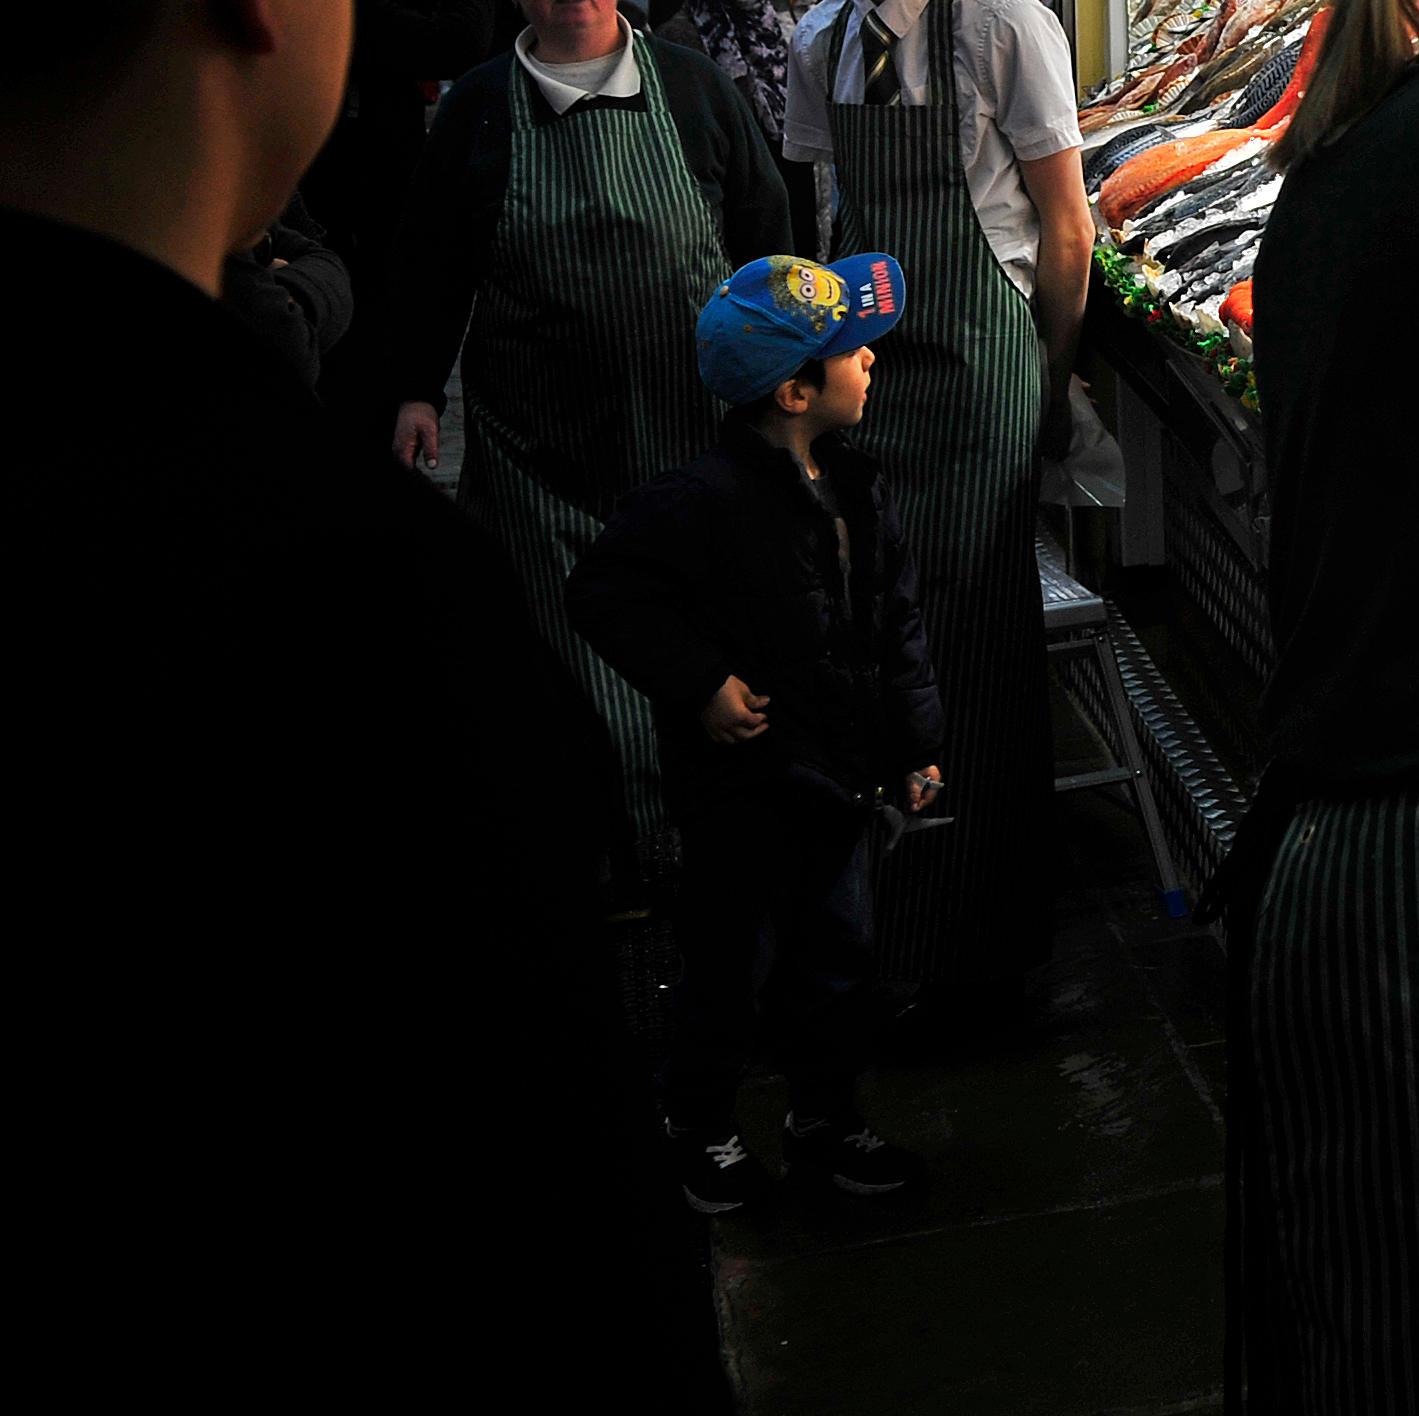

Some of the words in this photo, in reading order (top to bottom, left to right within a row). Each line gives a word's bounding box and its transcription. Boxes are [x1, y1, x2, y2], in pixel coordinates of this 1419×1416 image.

[860, 282, 873, 293] A
[870, 261, 896, 315] MINION
[860, 292, 875, 309] IN
